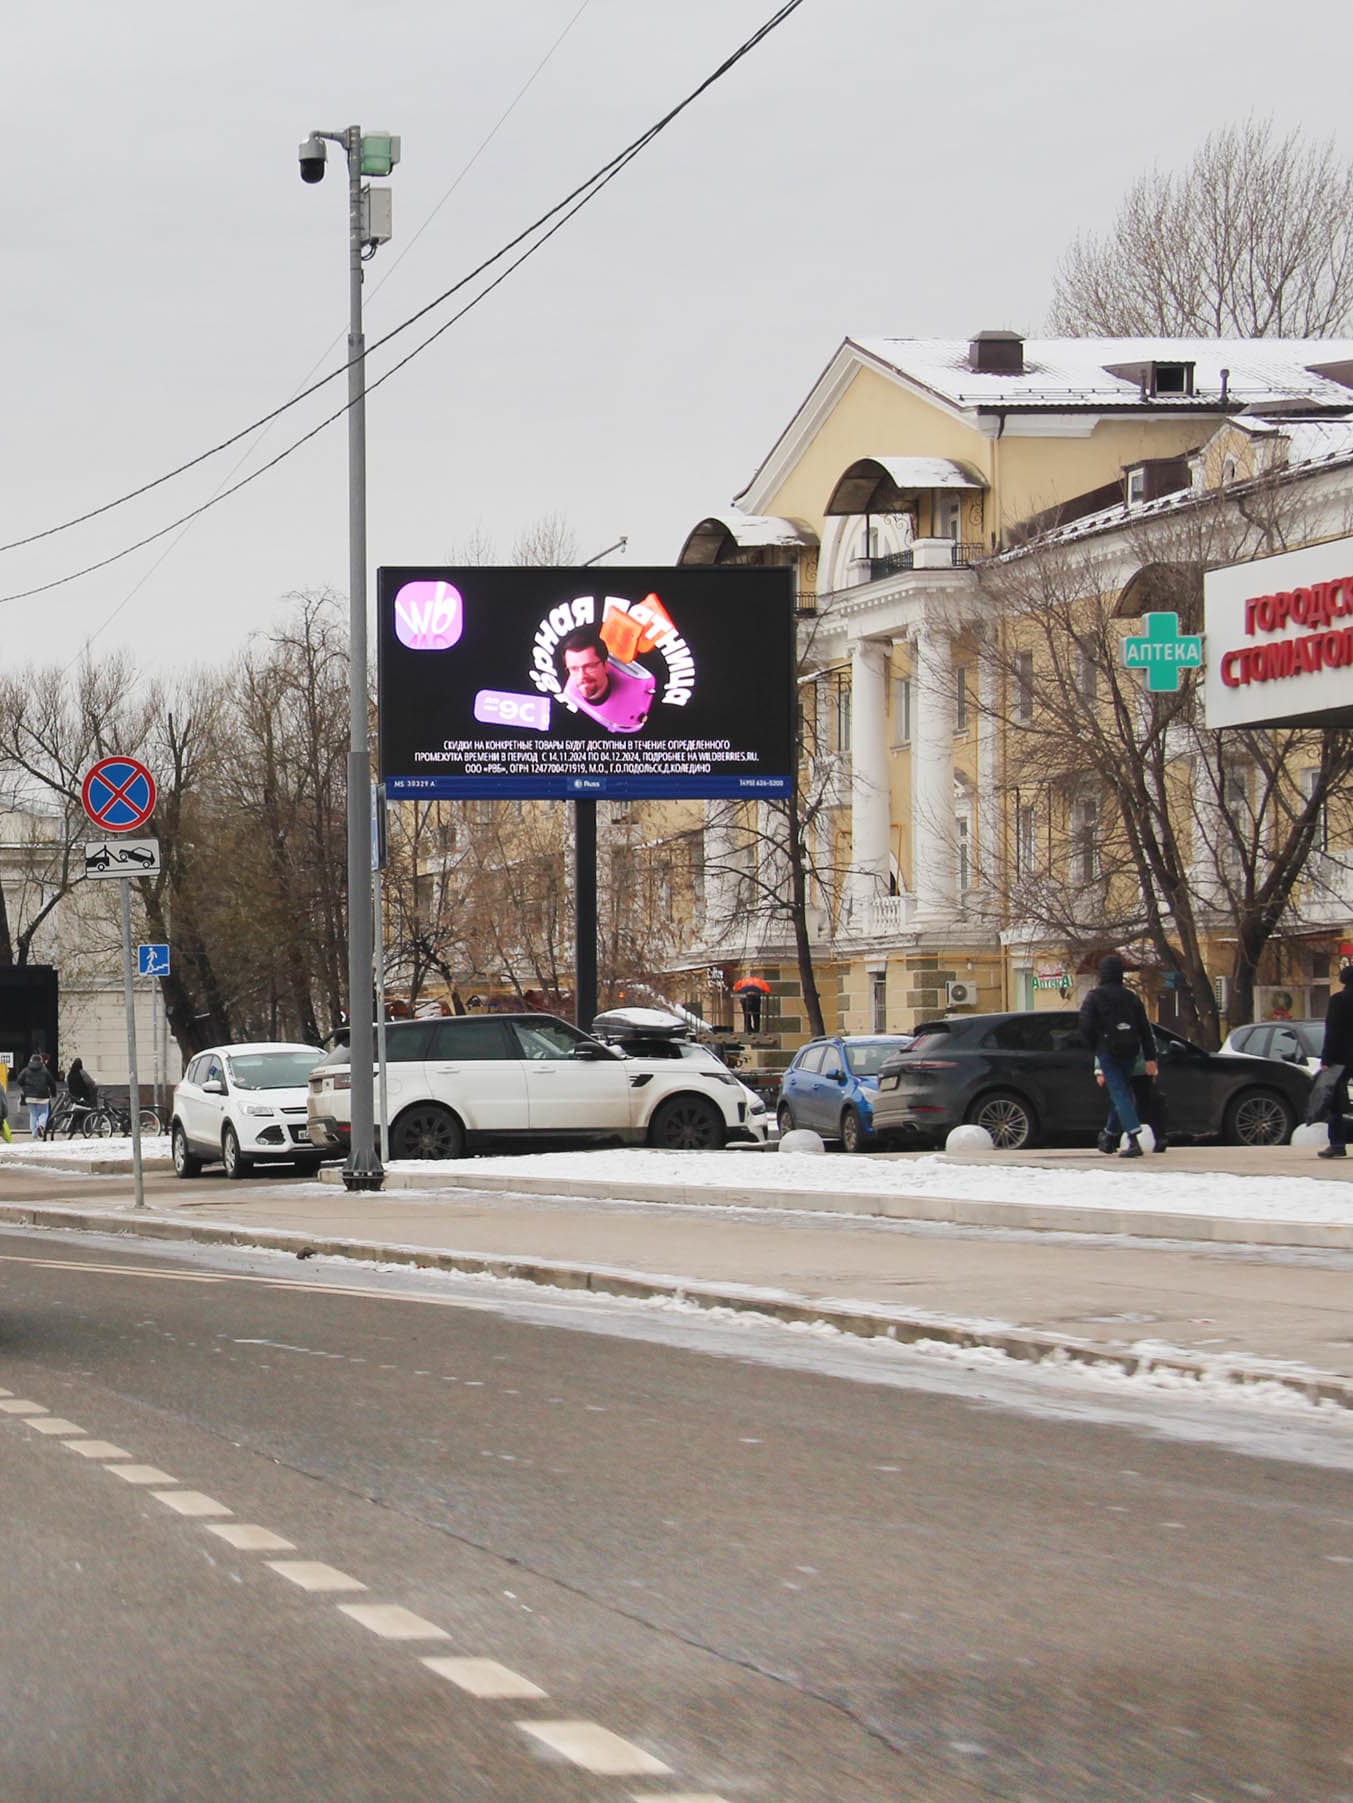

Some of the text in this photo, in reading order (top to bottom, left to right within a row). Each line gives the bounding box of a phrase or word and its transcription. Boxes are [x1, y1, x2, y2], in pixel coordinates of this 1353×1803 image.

[1127, 643, 1199, 661] АПТЕКА
[443, 741, 473, 751] СКИДКИ
[474, 741, 485, 750] НА
[486, 741, 533, 750] КОНКРЕТНЫЕ
[535, 741, 564, 750] ТОВАРЫ
[565, 740, 586, 751] БУДУТ
[587, 740, 627, 751] ДОСТУПНЫ
[634, 740, 666, 750] ТЕЧЕНИЕ
[667, 740, 730, 751] ОПРЕДЕЛЕННОГО
[414, 752, 463, 762] ПРОМЕЖУТКА
[464, 752, 499, 761] ВРЕМЕНИ
[508, 752, 538, 762] ПЕРИОД
[549, 752, 586, 761] 14.11.2024
[588, 752, 599, 761] ПО
[643, 752, 686, 762] ПОДРОБНЕЕ
[687, 752, 698, 761] НА
[465, 764, 482, 773] ООО
[509, 764, 529, 773] ОГРН
